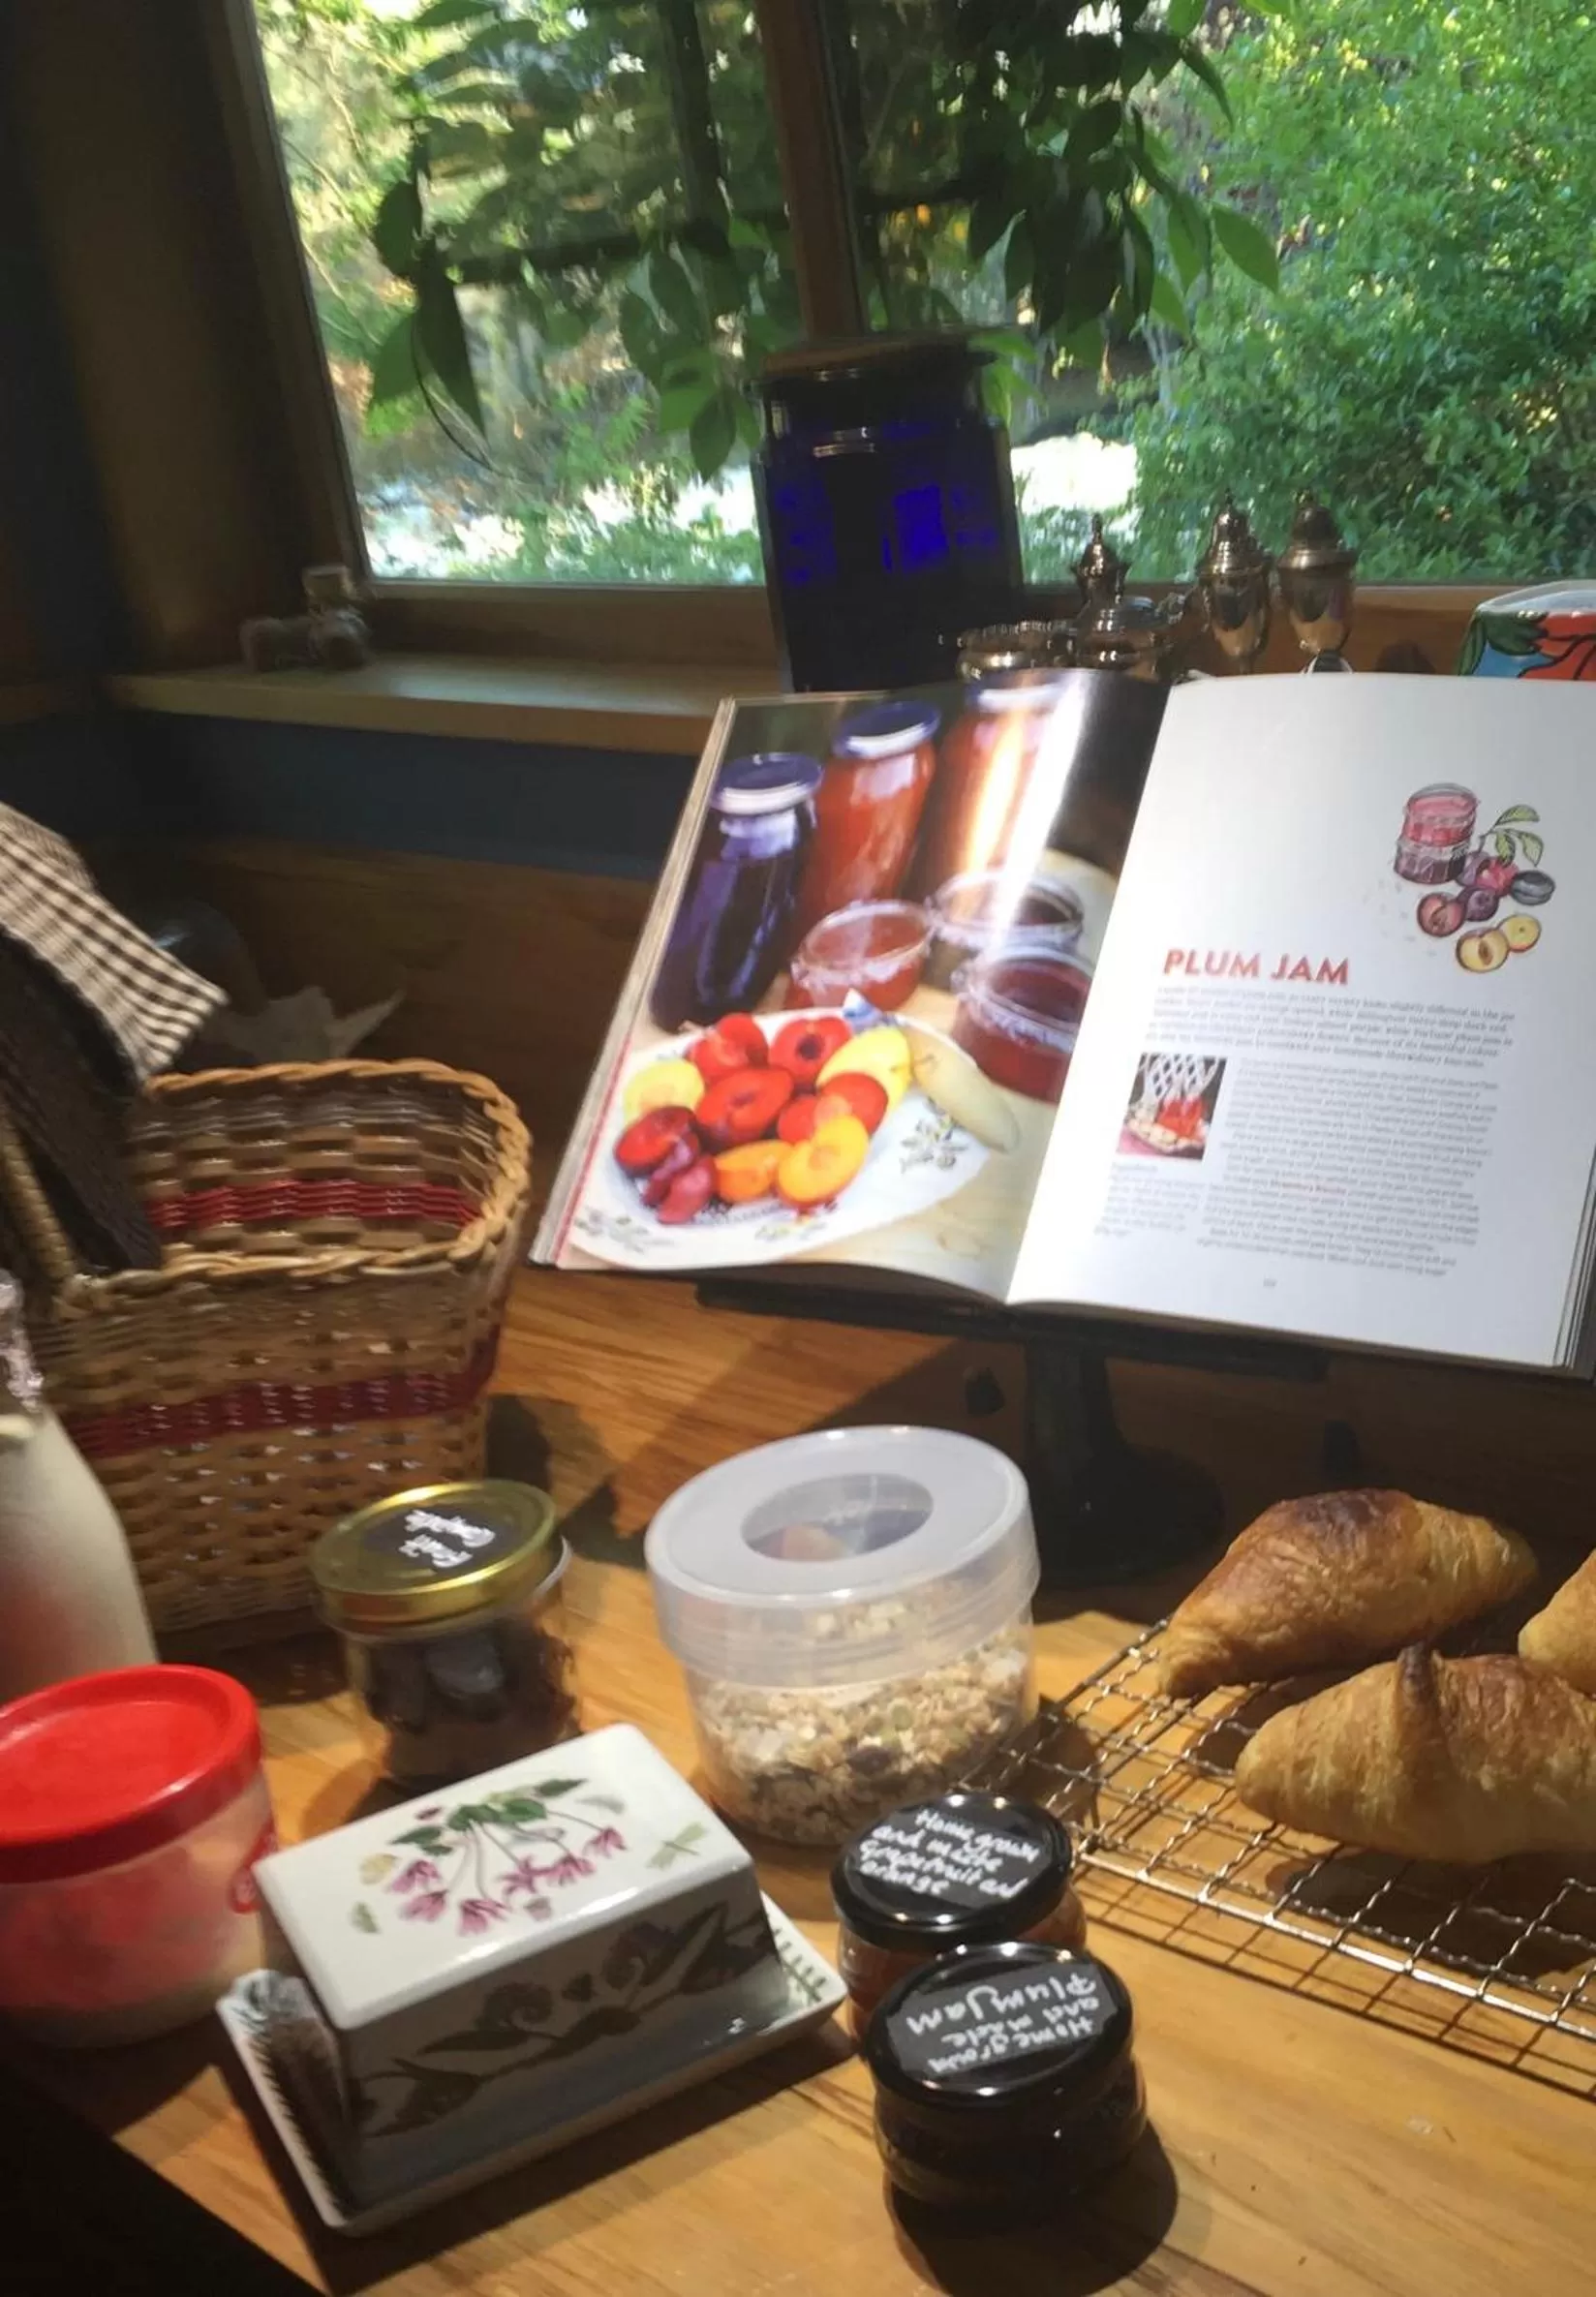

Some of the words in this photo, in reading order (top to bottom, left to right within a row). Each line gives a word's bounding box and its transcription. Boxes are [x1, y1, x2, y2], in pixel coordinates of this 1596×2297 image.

[1163, 948, 1261, 979] PLUM
[1270, 953, 1349, 985] JAM
[873, 1825, 927, 1849] and
[978, 1878, 1029, 1899] and
[905, 1984, 999, 2035] Jam
[990, 1973, 1097, 2014] Plum
[1042, 1996, 1100, 2024] and
